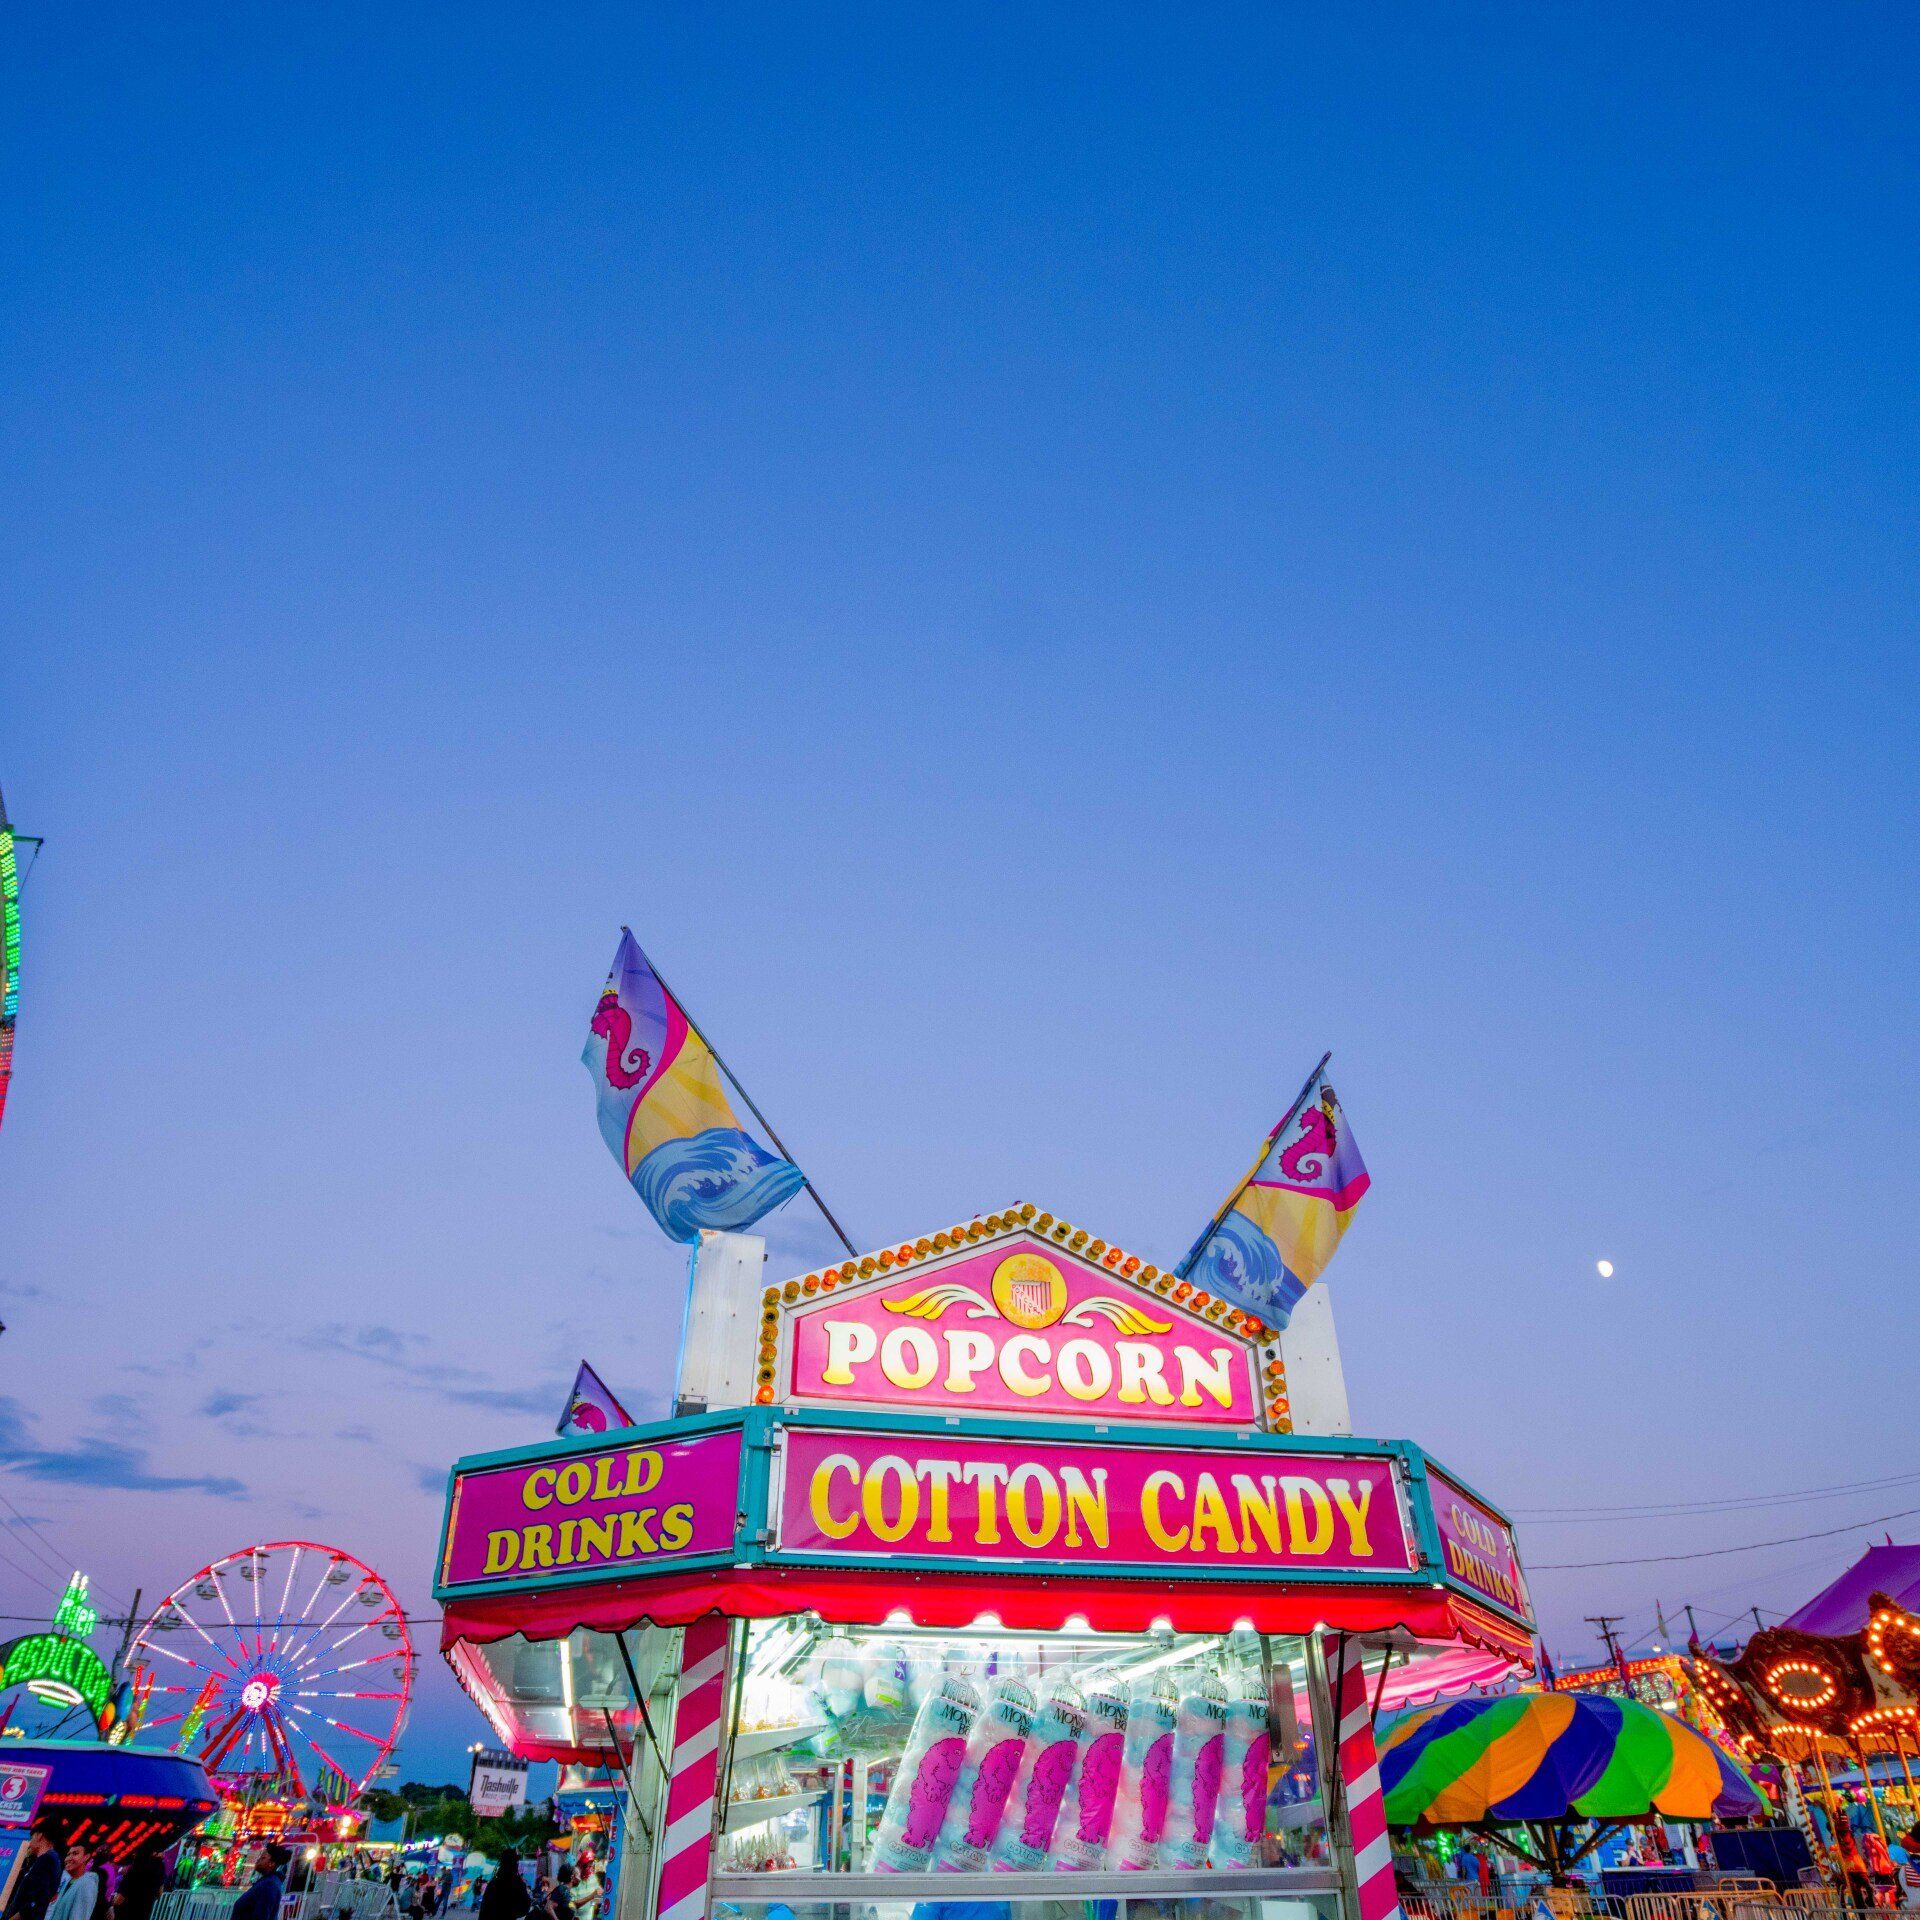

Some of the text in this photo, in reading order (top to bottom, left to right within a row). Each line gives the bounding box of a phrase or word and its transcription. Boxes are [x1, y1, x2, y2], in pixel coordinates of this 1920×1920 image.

[821, 1320, 1233, 1409] POPCORN
[522, 1450, 664, 1511] COLD
[809, 1453, 1374, 1557] COTTON CANDY
[482, 1503, 695, 1575] DRINKS
[1451, 1503, 1497, 1558] COLD
[1447, 1538, 1515, 1607] DRINKS
[5, 1777, 24, 1799] 3
[480, 1774, 520, 1800] Nashville
